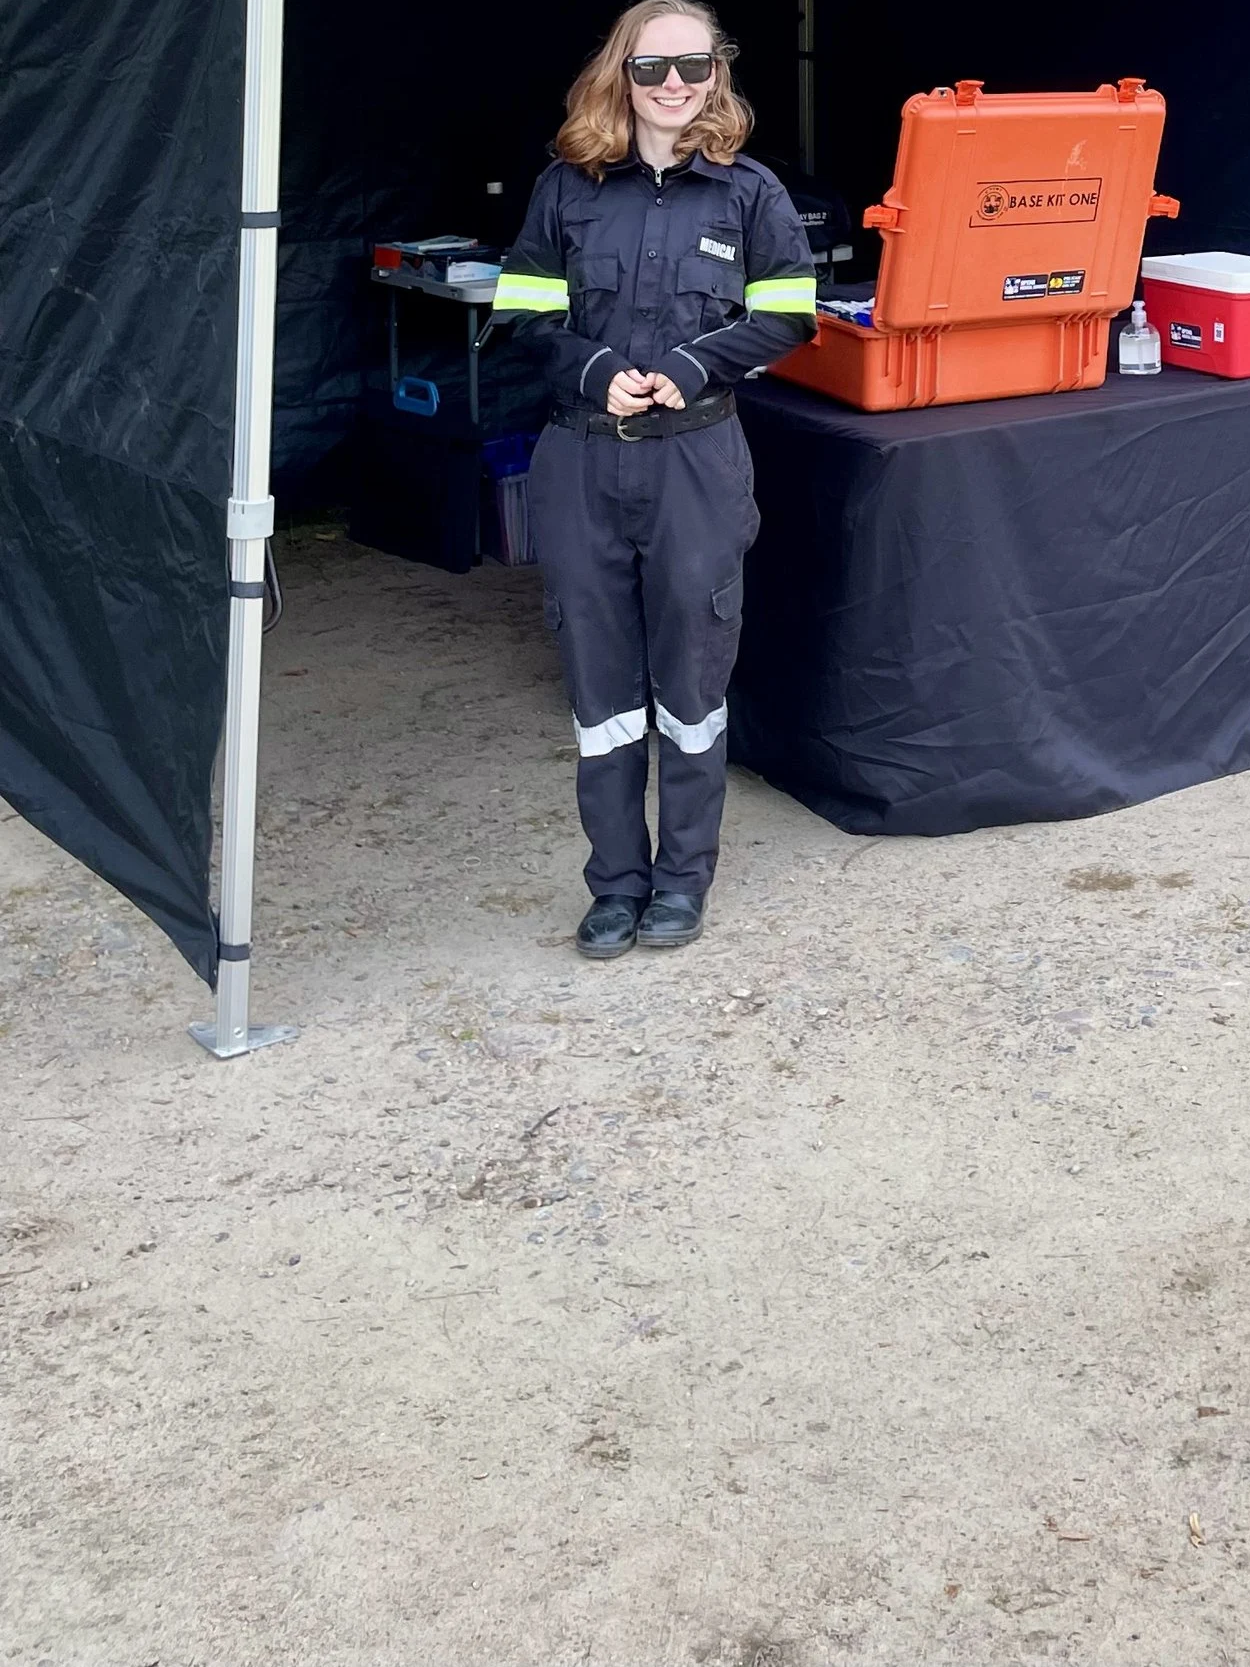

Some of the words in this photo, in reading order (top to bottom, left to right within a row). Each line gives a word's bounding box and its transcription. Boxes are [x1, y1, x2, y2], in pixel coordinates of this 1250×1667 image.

[1009, 195, 1043, 208] BASE
[1047, 194, 1065, 207] KIT
[1069, 193, 1097, 205] ONE
[700, 237, 736, 261] MEDICAL
